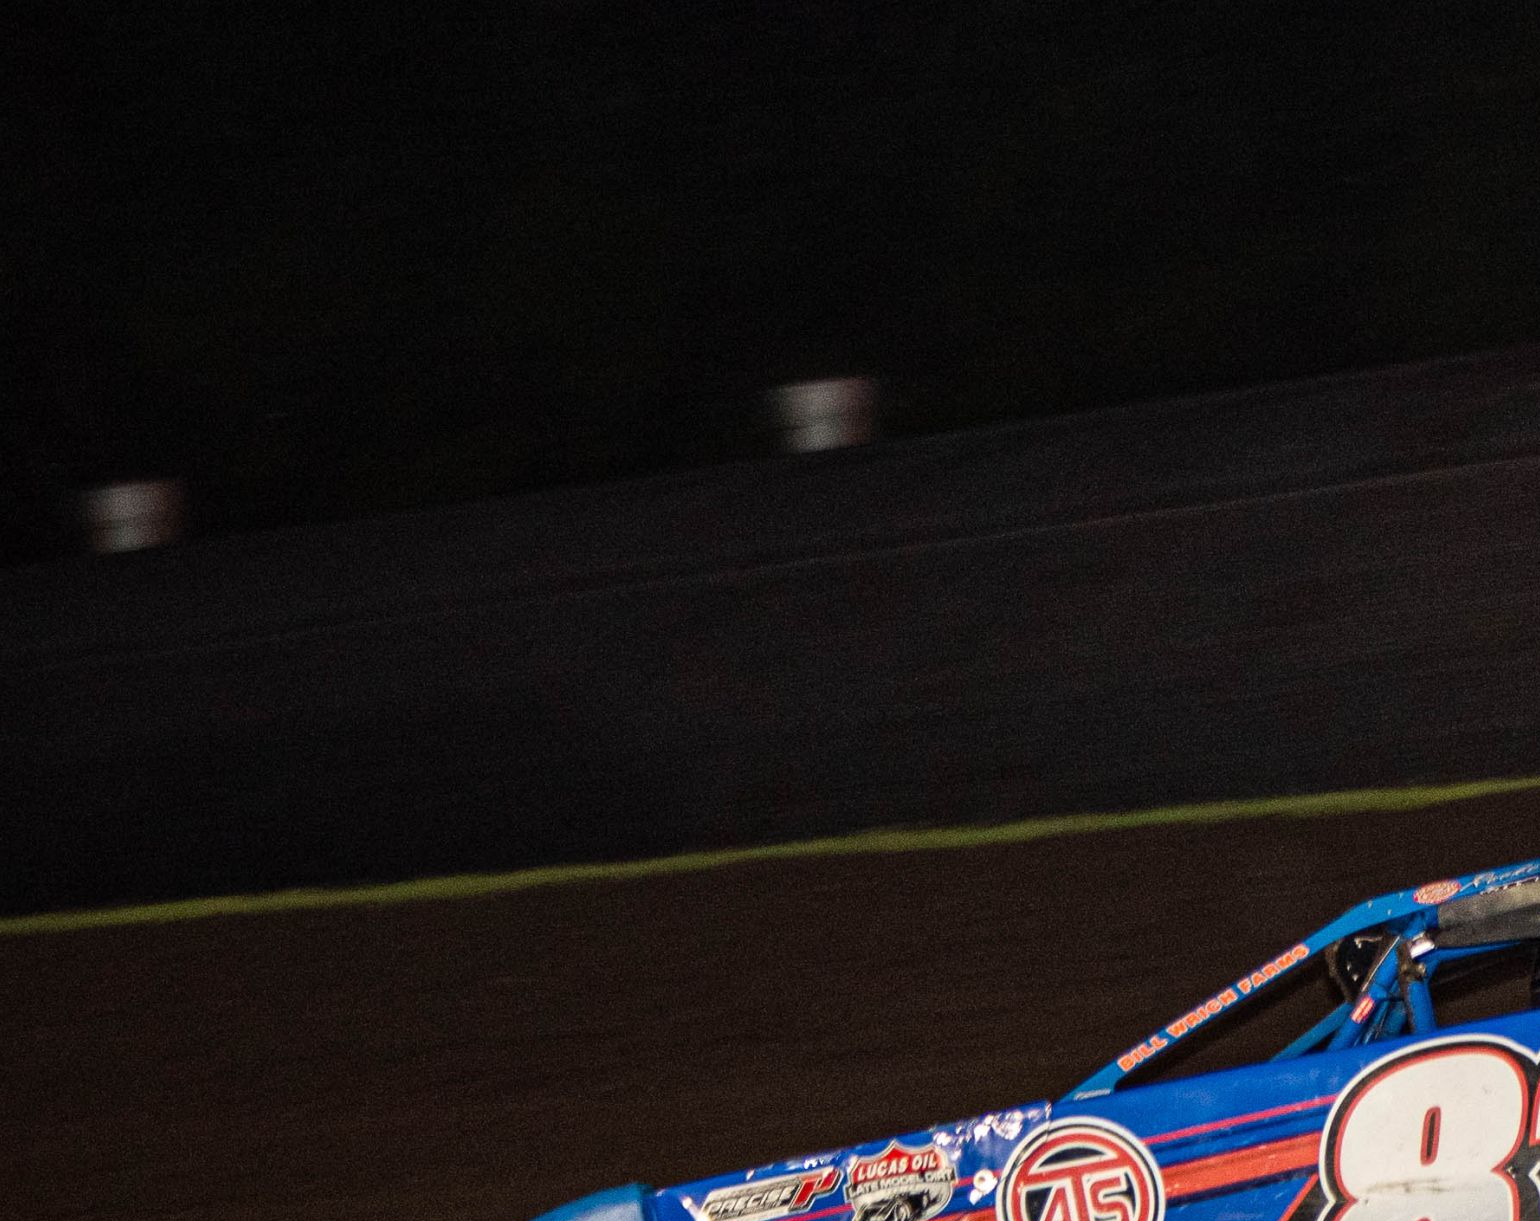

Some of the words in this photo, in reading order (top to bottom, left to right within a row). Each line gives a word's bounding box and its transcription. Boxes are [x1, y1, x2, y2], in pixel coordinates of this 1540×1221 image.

[1117, 1034, 1168, 1072] BILL
[1236, 943, 1310, 995] FARMS
[858, 1160, 909, 1181] LUCAS
[911, 1152, 938, 1171] OIL
